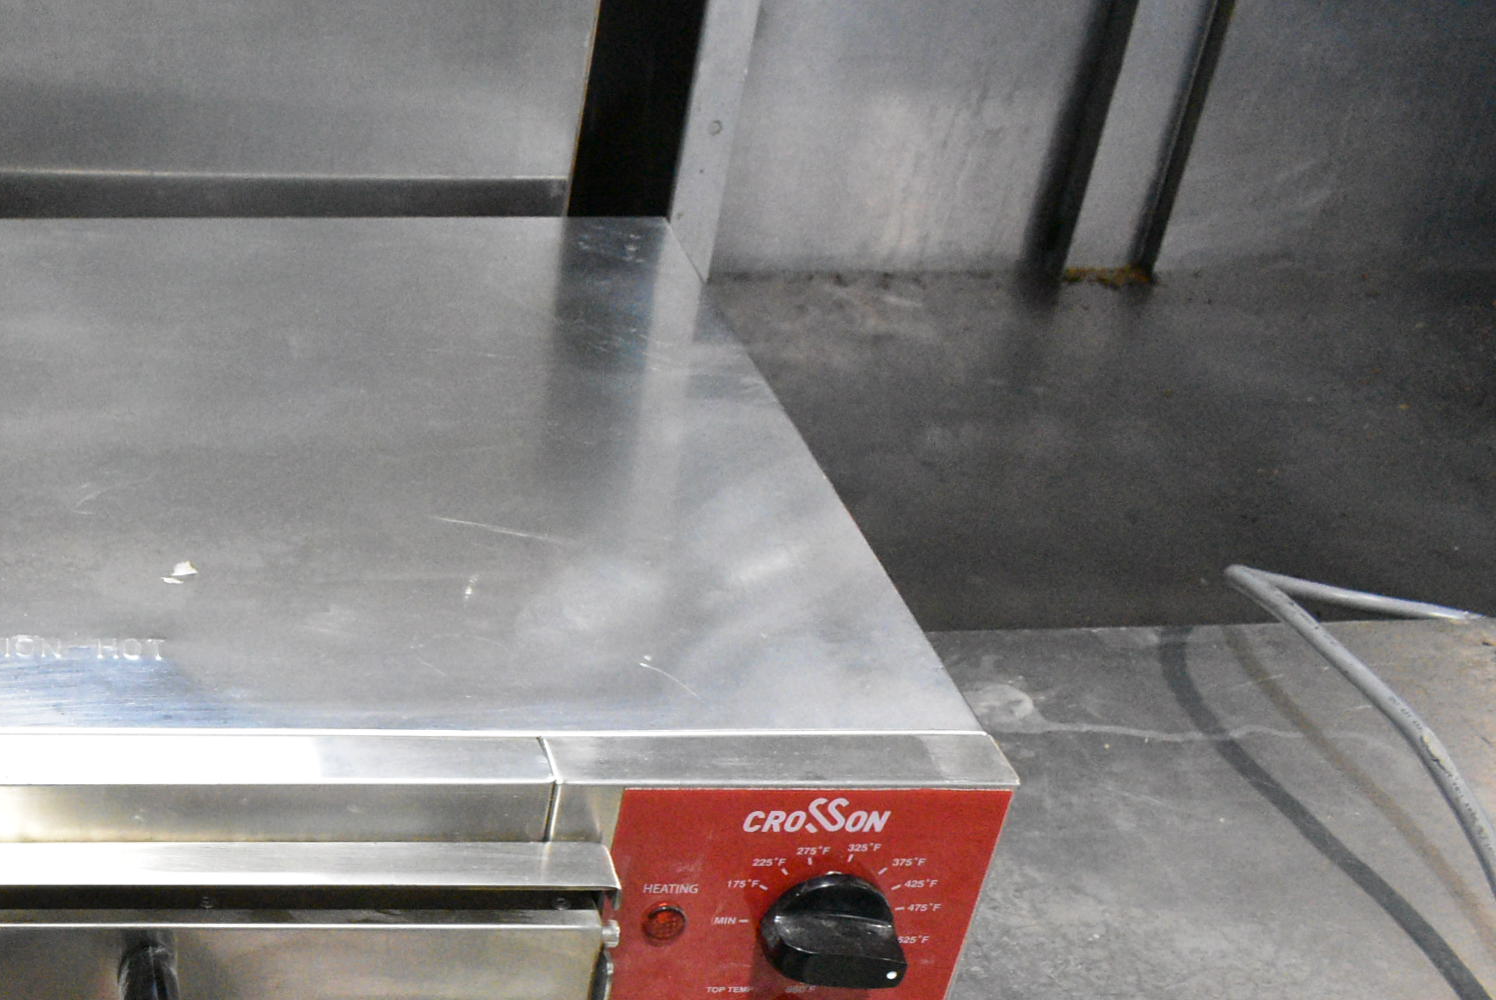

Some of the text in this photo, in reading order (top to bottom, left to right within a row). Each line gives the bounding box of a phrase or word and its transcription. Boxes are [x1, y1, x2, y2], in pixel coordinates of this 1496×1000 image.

[743, 797, 892, 834] CROSSON
[643, 883, 700, 894] HEATING
[713, 916, 737, 925] MIN
[705, 986, 754, 994] TOP TEMP
